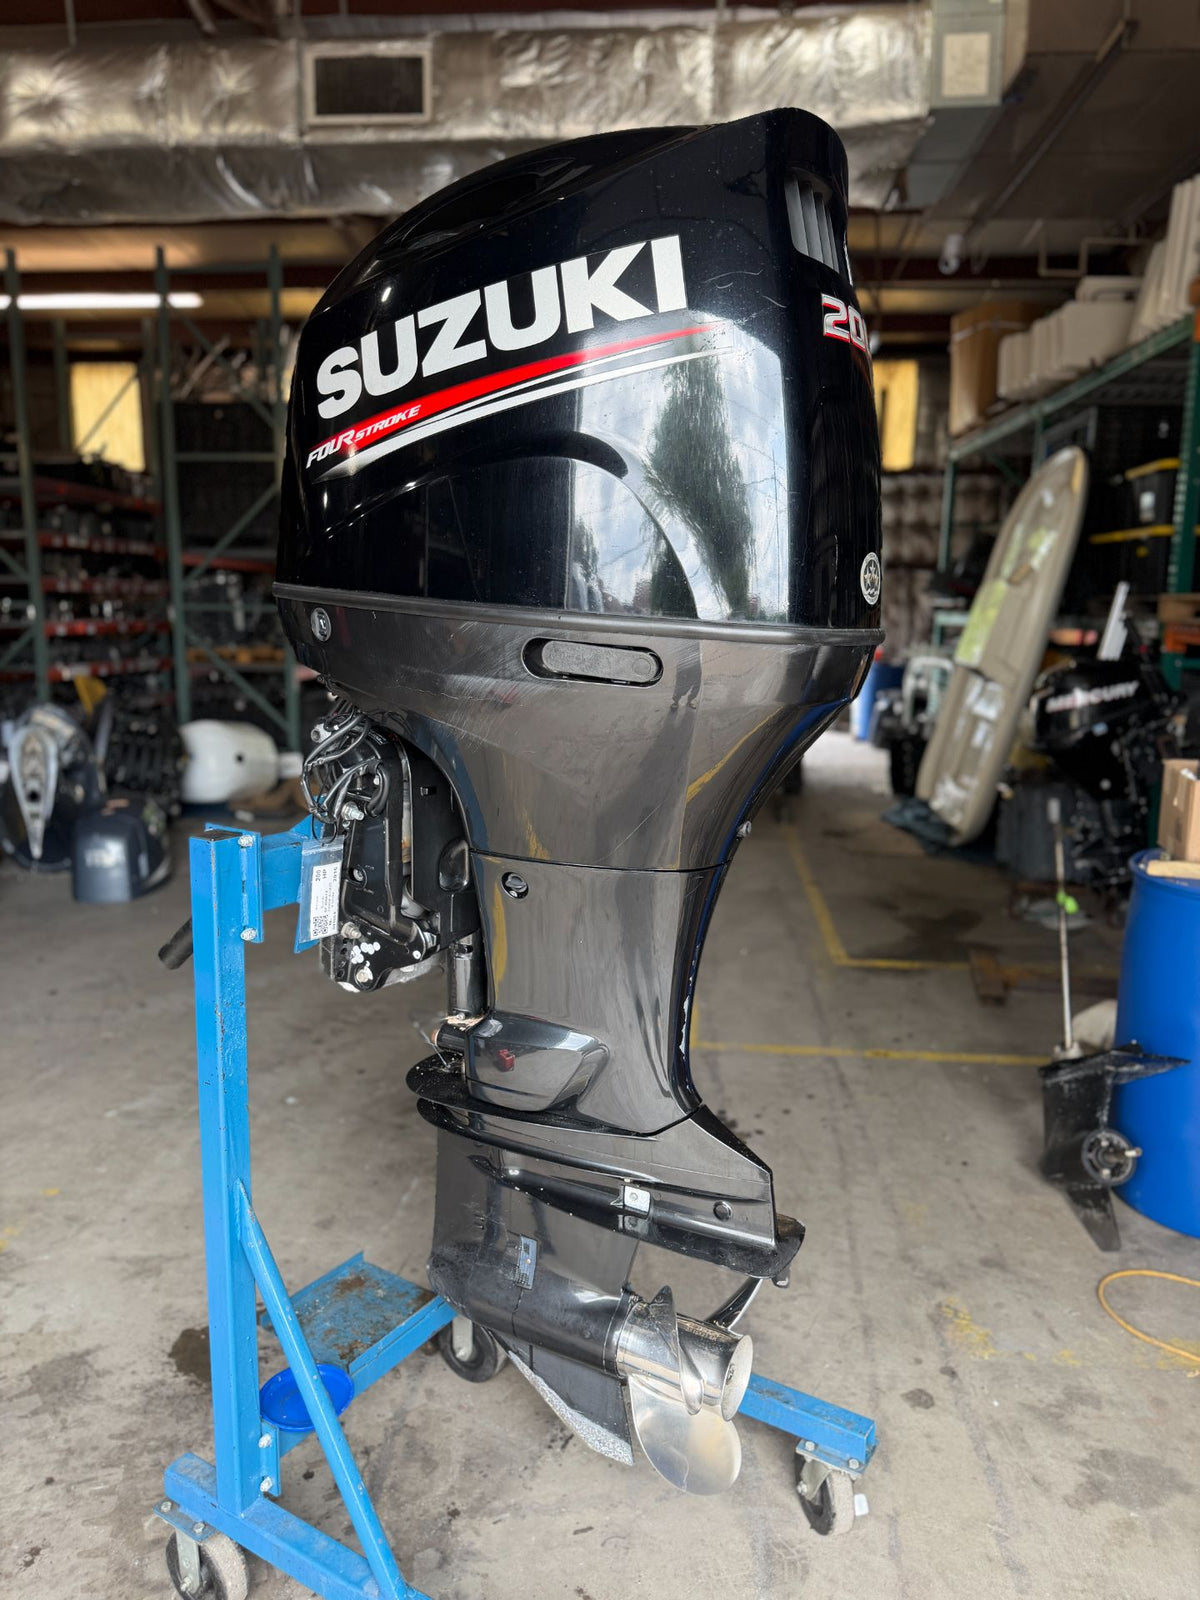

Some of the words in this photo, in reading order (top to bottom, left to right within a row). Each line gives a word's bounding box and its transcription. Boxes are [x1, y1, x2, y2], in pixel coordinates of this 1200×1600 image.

[316, 235, 688, 419] SUZUKI
[821, 293, 871, 356] 20
[305, 429, 355, 469] FOUR
[354, 404, 421, 442] STROKE
